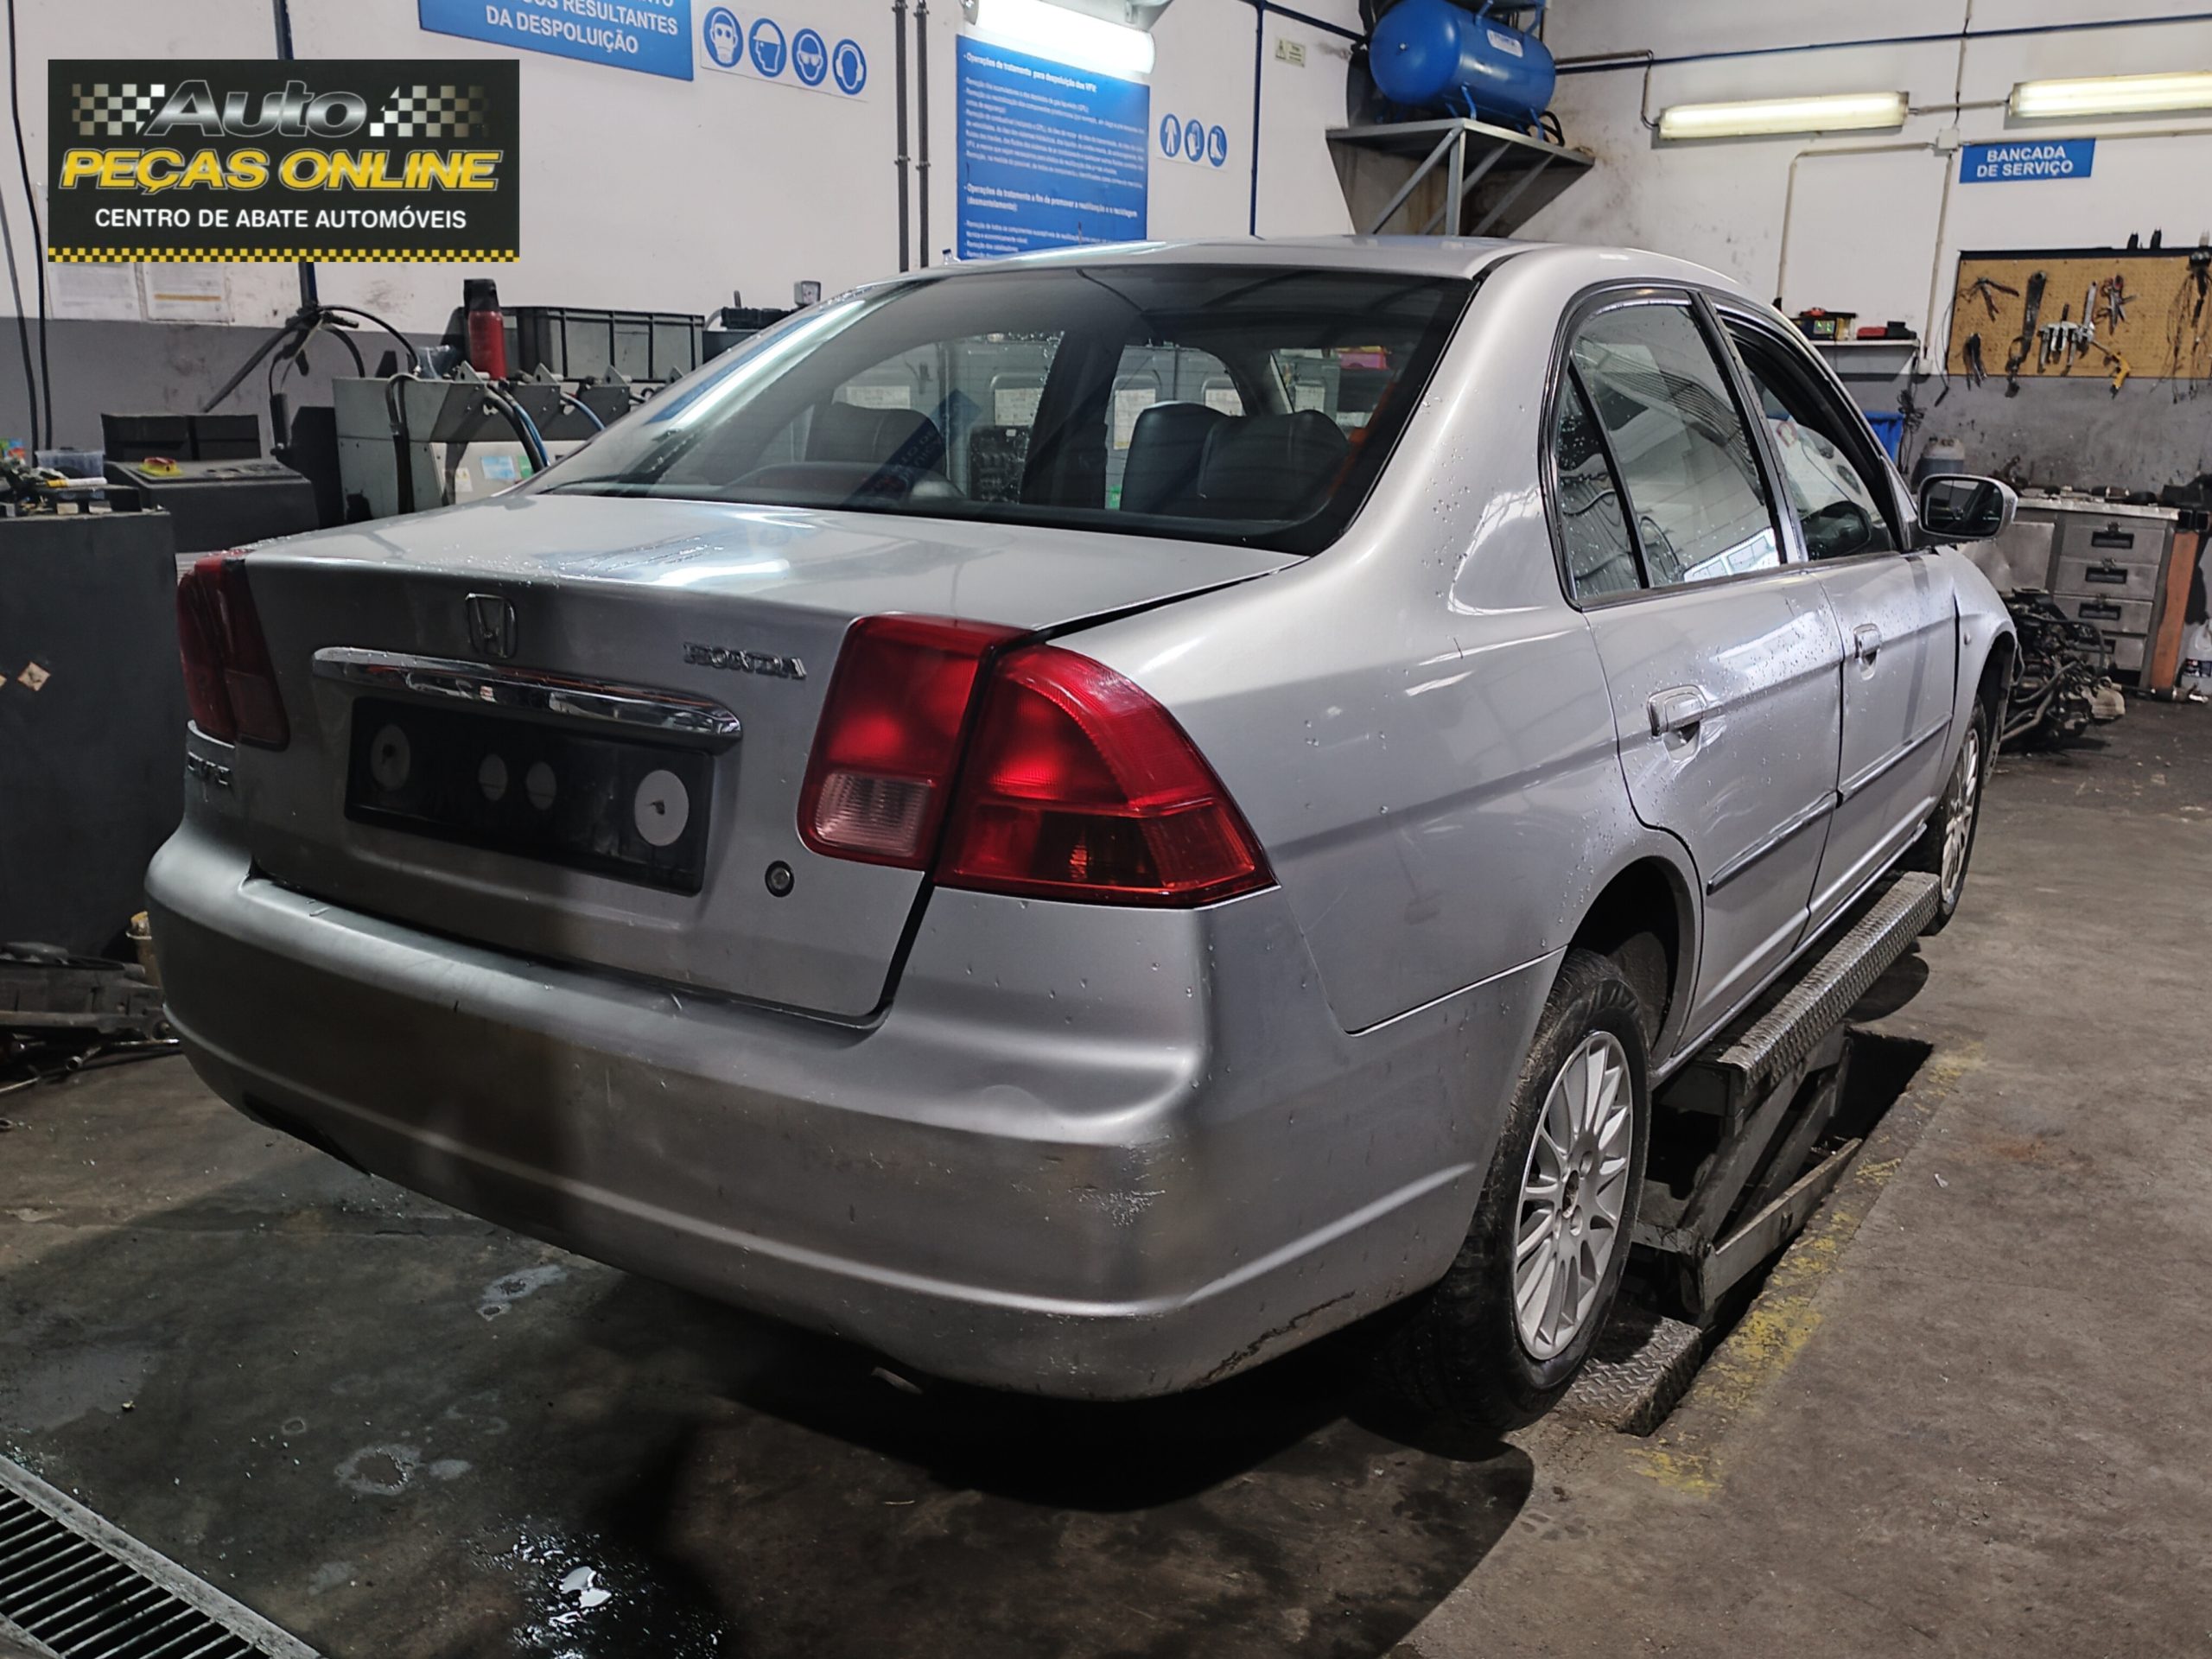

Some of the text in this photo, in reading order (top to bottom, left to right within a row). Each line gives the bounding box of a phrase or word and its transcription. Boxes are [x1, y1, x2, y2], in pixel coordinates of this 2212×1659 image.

[486, 5, 639, 53] DA DESPOLUIÇÃO
[563, 0, 678, 35] RESULTANTES
[1986, 145, 2066, 162] BANCADA
[1977, 160, 2073, 178] DE SERVIÇO
